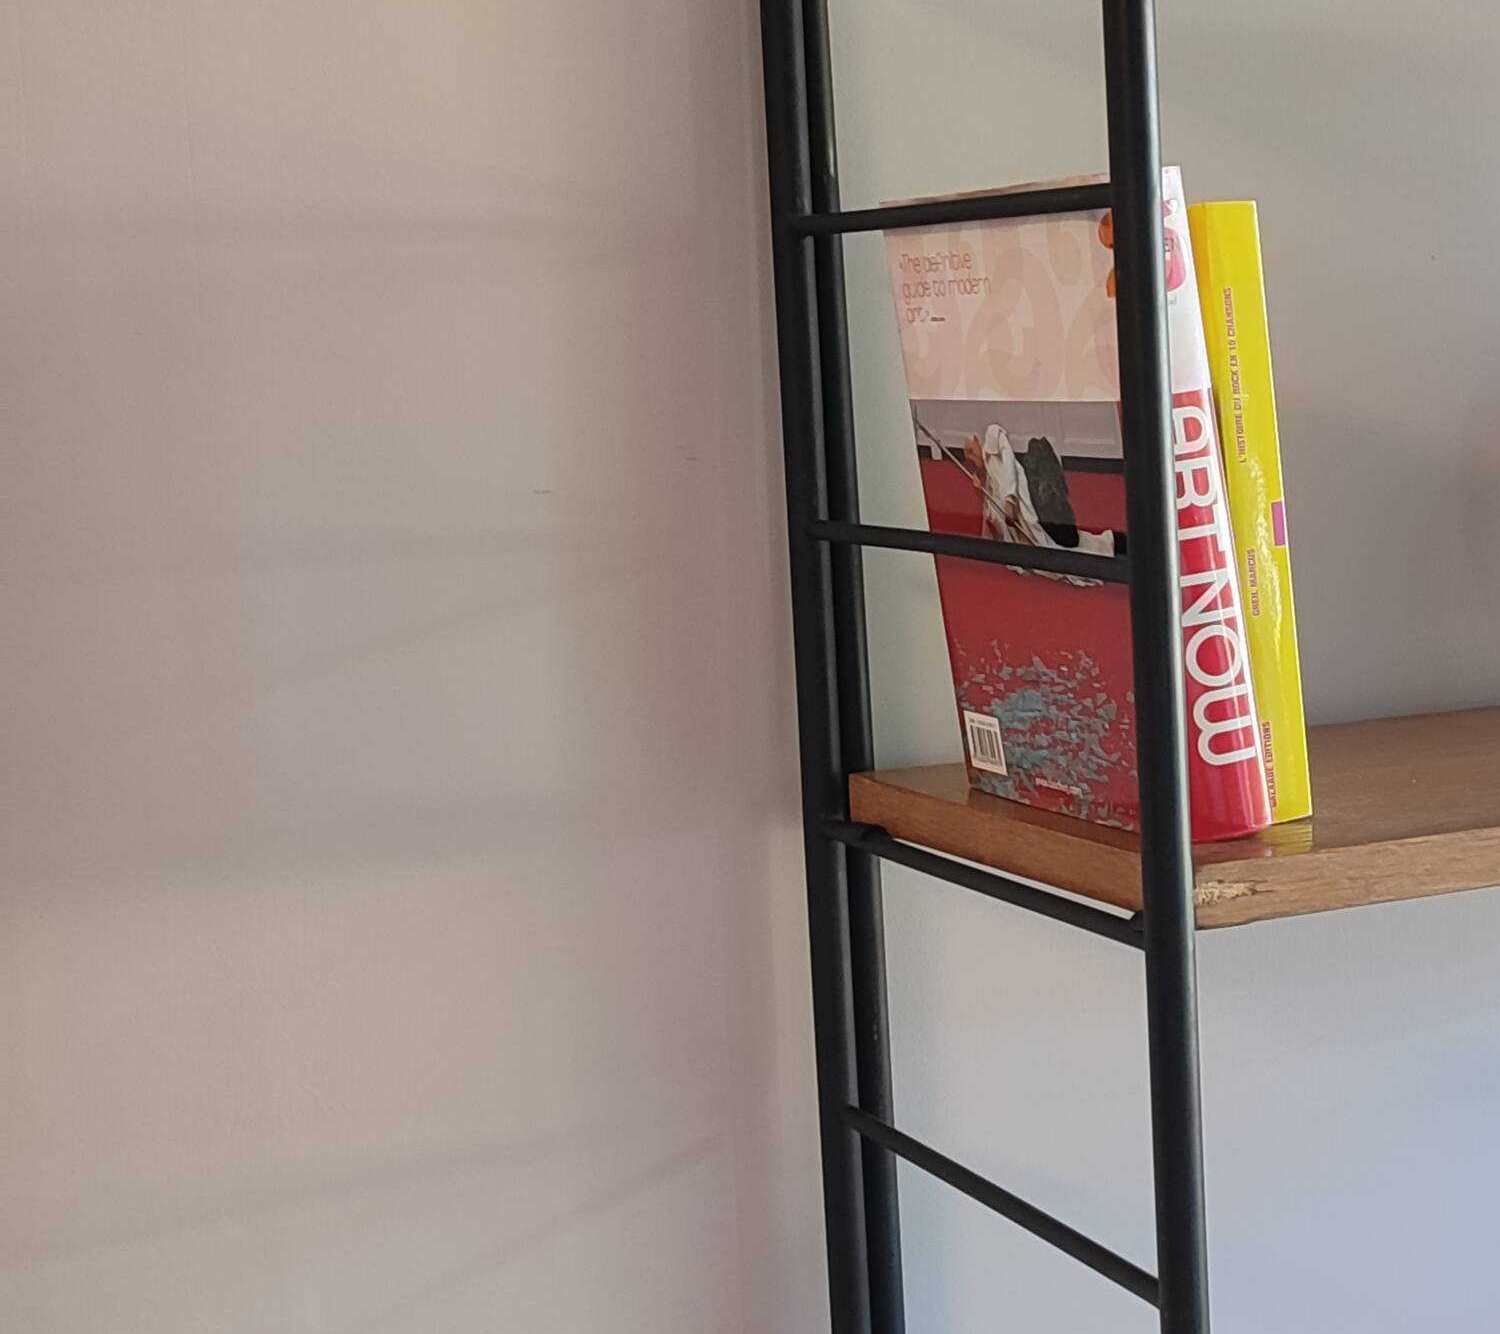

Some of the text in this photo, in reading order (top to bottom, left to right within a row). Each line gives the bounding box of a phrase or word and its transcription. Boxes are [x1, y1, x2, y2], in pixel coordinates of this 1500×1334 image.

[932, 278, 946, 298] to
[1224, 287, 1236, 337] CHANSONS
[1230, 354, 1238, 367] EN
[1231, 369, 1242, 395] ROCK
[1233, 397, 1242, 410] DU
[1180, 568, 1258, 767] NOW
